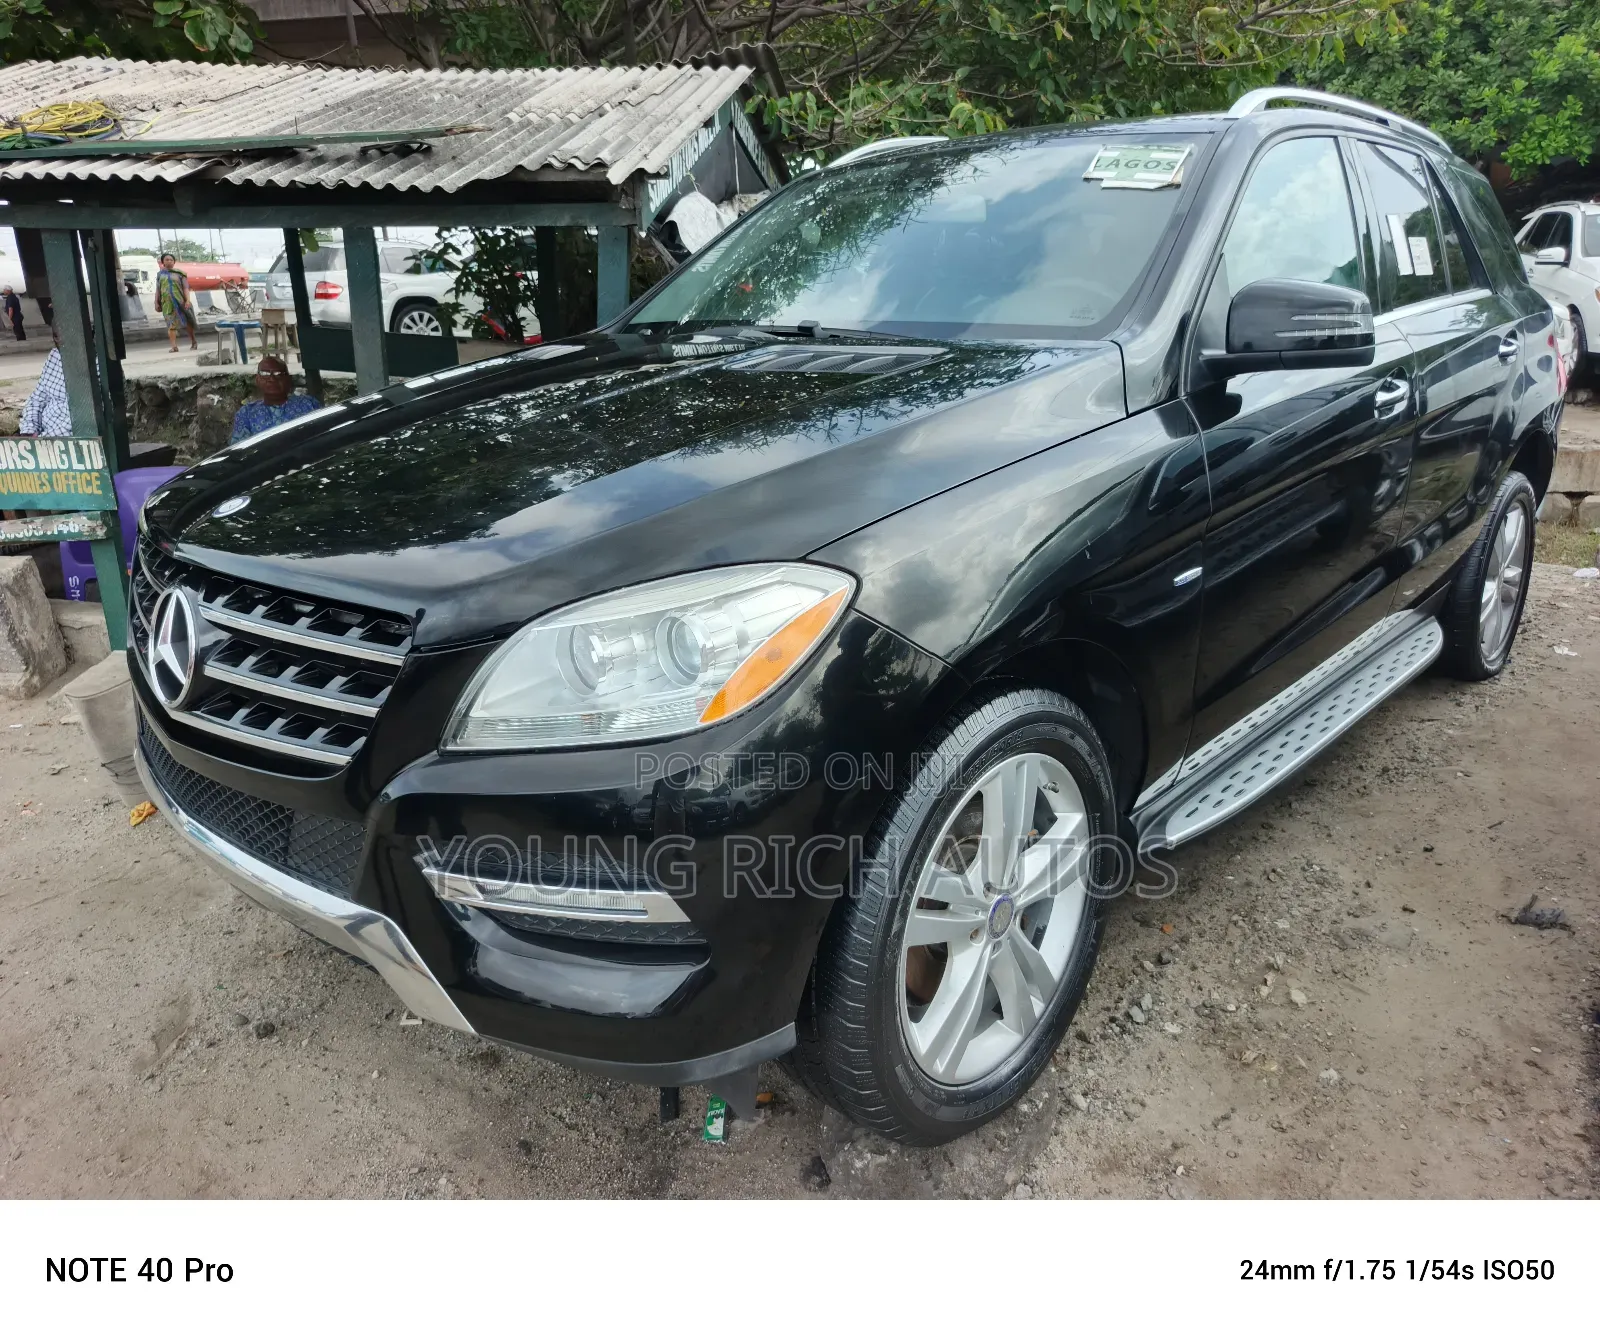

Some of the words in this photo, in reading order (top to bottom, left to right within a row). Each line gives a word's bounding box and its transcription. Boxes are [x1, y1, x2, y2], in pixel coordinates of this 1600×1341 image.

[34, 440, 69, 470] NIG
[68, 440, 103, 470] LTD
[52, 471, 103, 495] OFFICE
